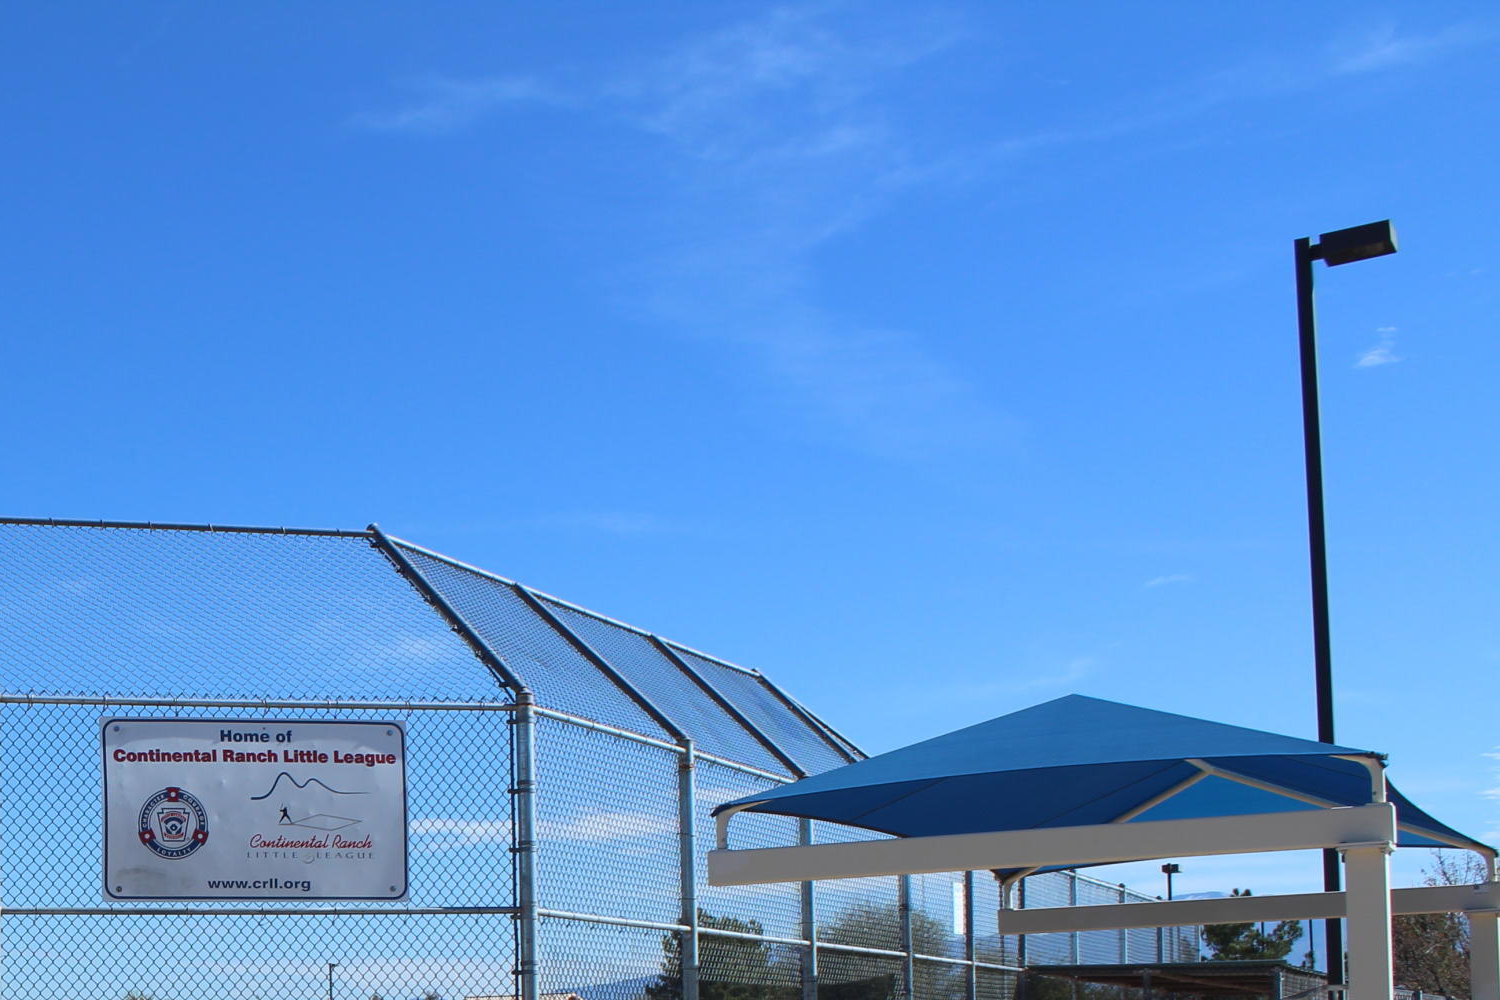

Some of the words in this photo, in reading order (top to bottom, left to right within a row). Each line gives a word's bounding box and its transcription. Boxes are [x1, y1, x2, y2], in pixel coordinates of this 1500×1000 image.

[220, 729, 269, 743] Home
[275, 729, 292, 743] of
[113, 748, 217, 763] Continental
[222, 749, 278, 763] Ranch
[283, 749, 328, 764] Little
[333, 750, 396, 767] League
[249, 834, 329, 849] Continental
[332, 834, 373, 849] Ranch
[156, 847, 191, 857] LOYALTY
[247, 851, 299, 859] LITTLE
[316, 851, 376, 859] LEAGUE
[208, 878, 311, 892] www.crll.org
